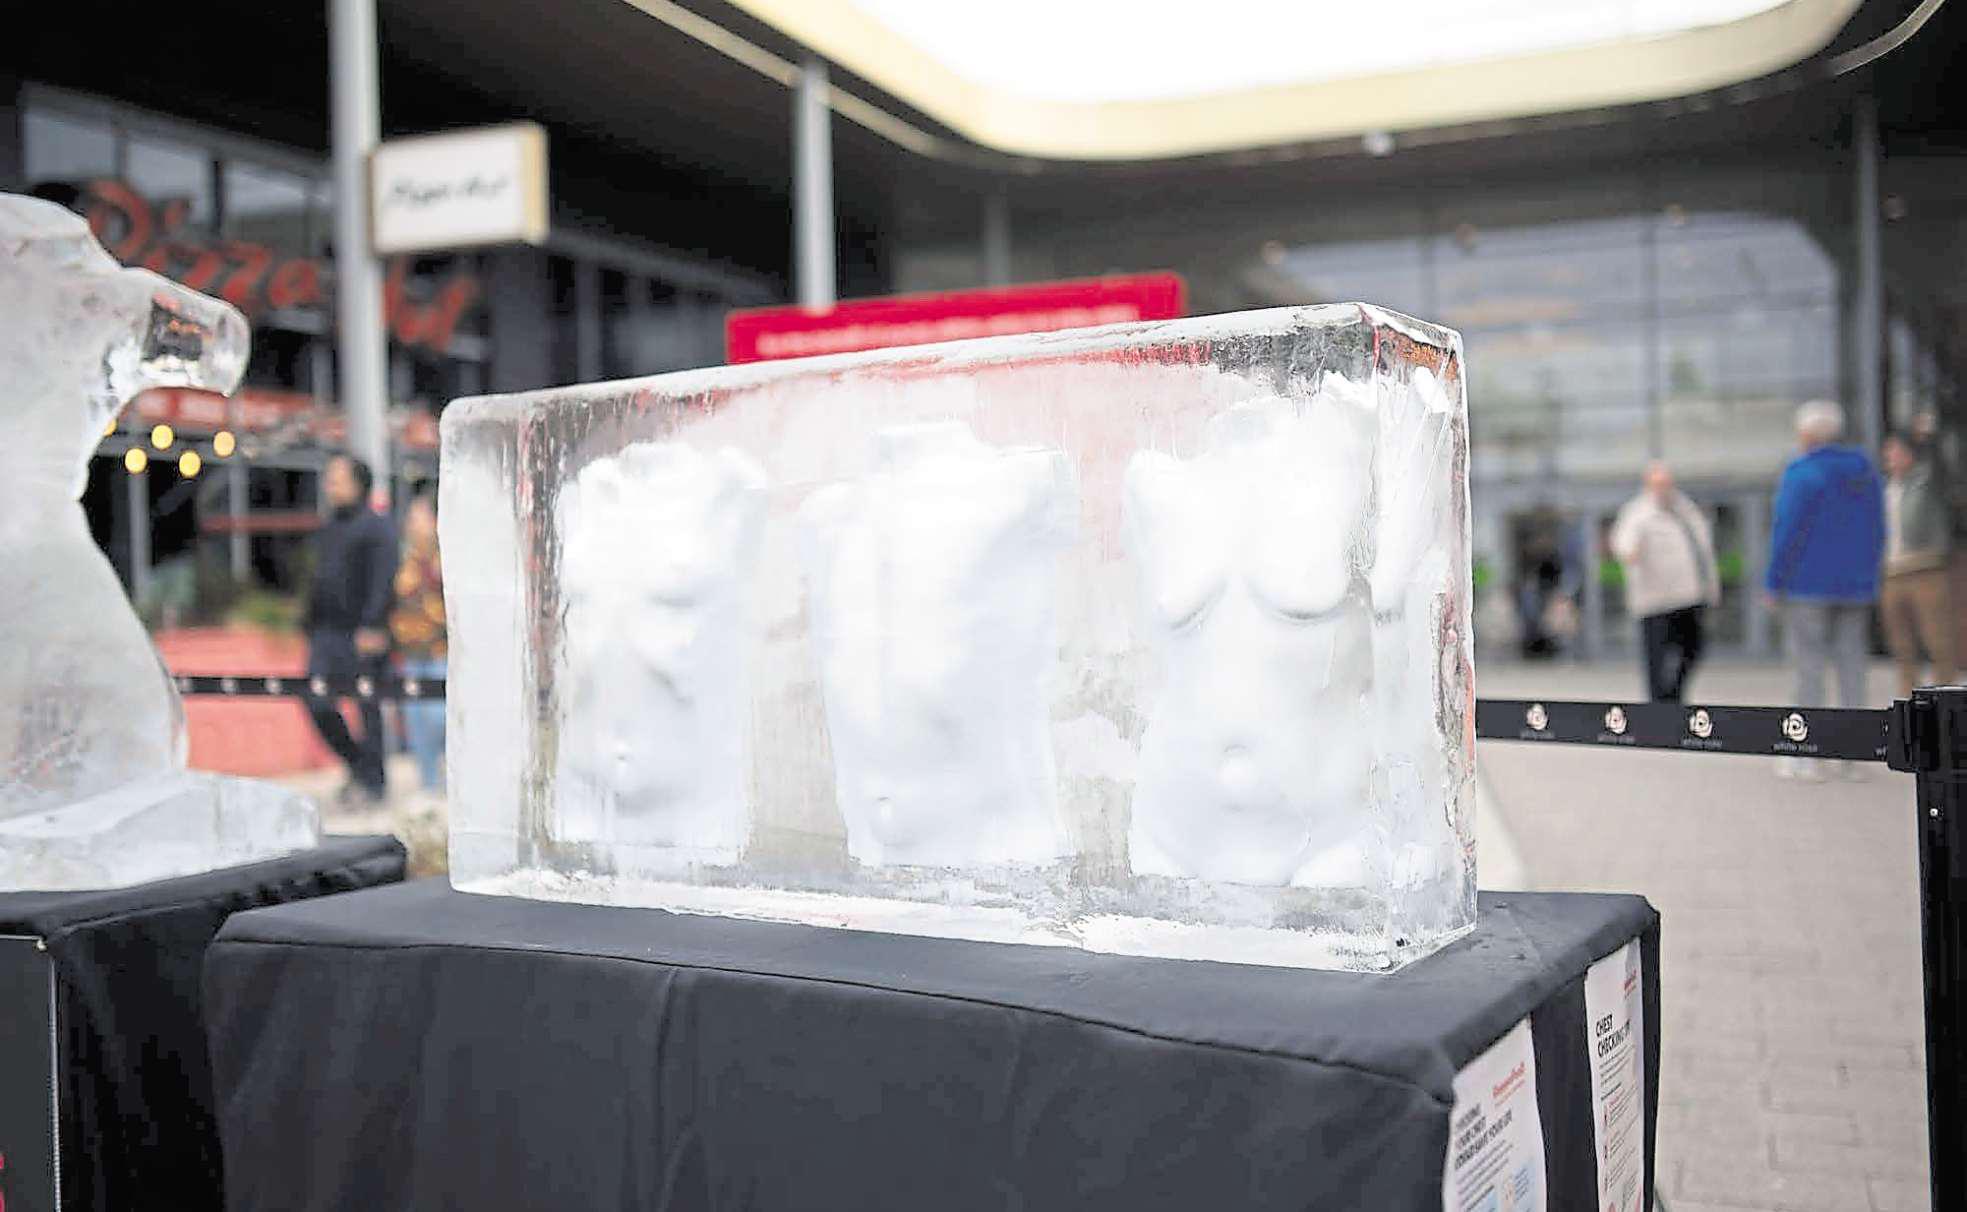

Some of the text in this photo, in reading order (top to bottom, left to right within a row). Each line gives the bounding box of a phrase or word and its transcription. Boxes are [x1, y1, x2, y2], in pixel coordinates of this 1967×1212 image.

[1773, 741, 1818, 753] white rose
[1595, 1013, 1613, 1038] CHEST
